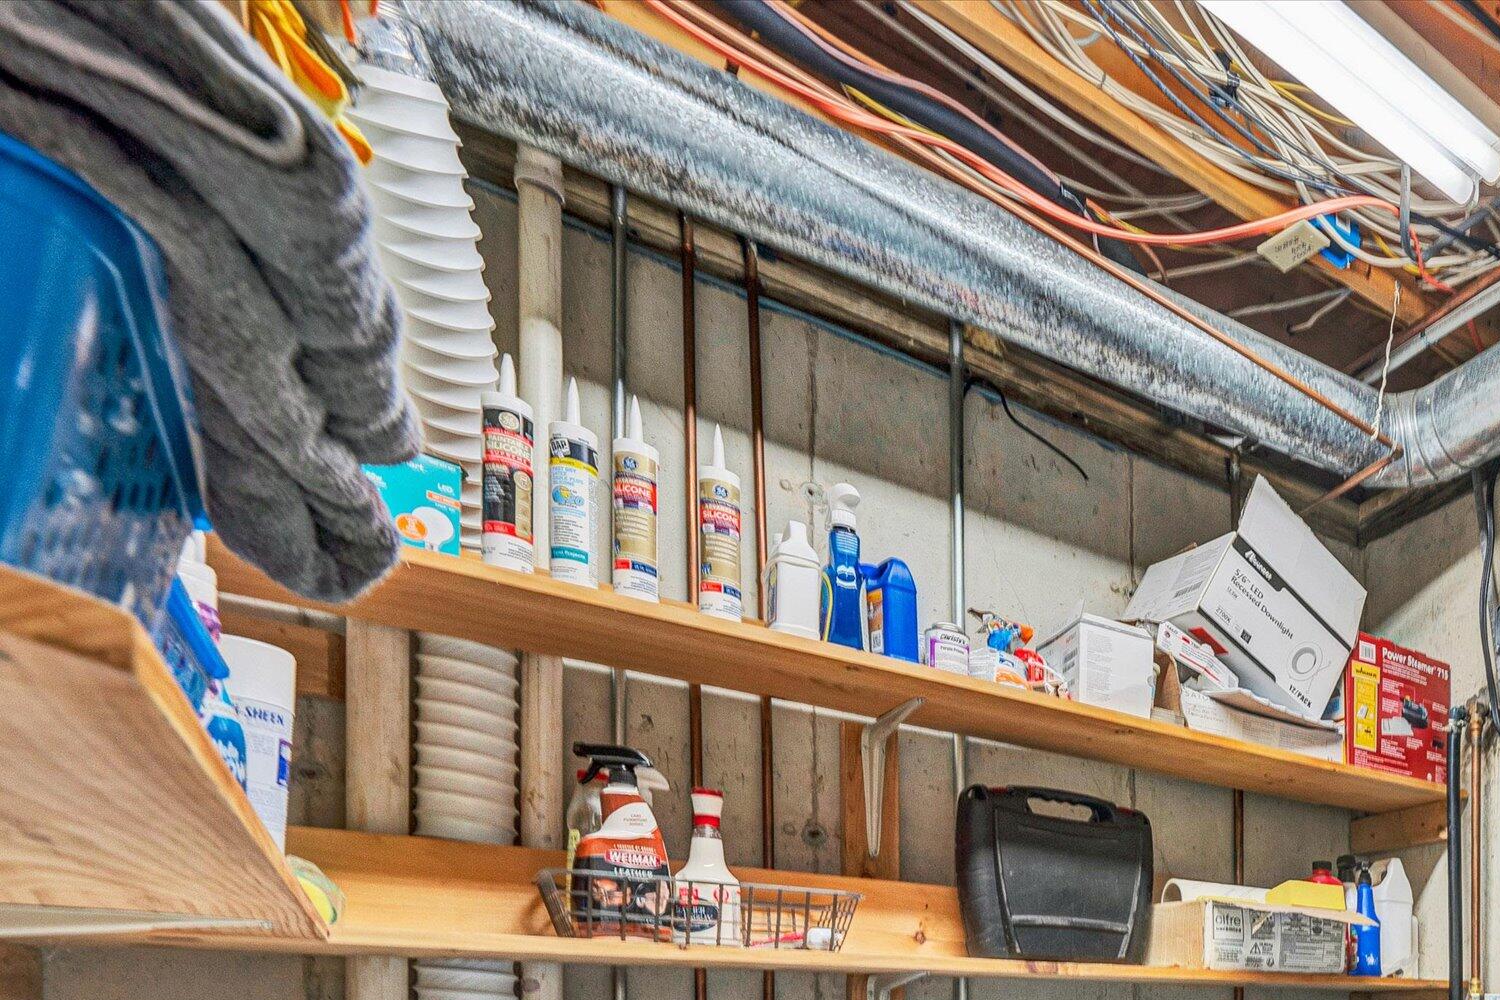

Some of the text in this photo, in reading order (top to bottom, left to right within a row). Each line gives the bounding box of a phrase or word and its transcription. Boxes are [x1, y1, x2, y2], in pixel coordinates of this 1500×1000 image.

[703, 511, 738, 524] SILICONE
[1250, 584, 1264, 600] LED
[1230, 576, 1294, 640] Recessed Downlight
[1382, 647, 1406, 663] Power
[608, 850, 659, 868] WEIMAN
[613, 867, 654, 879] LEATHER
